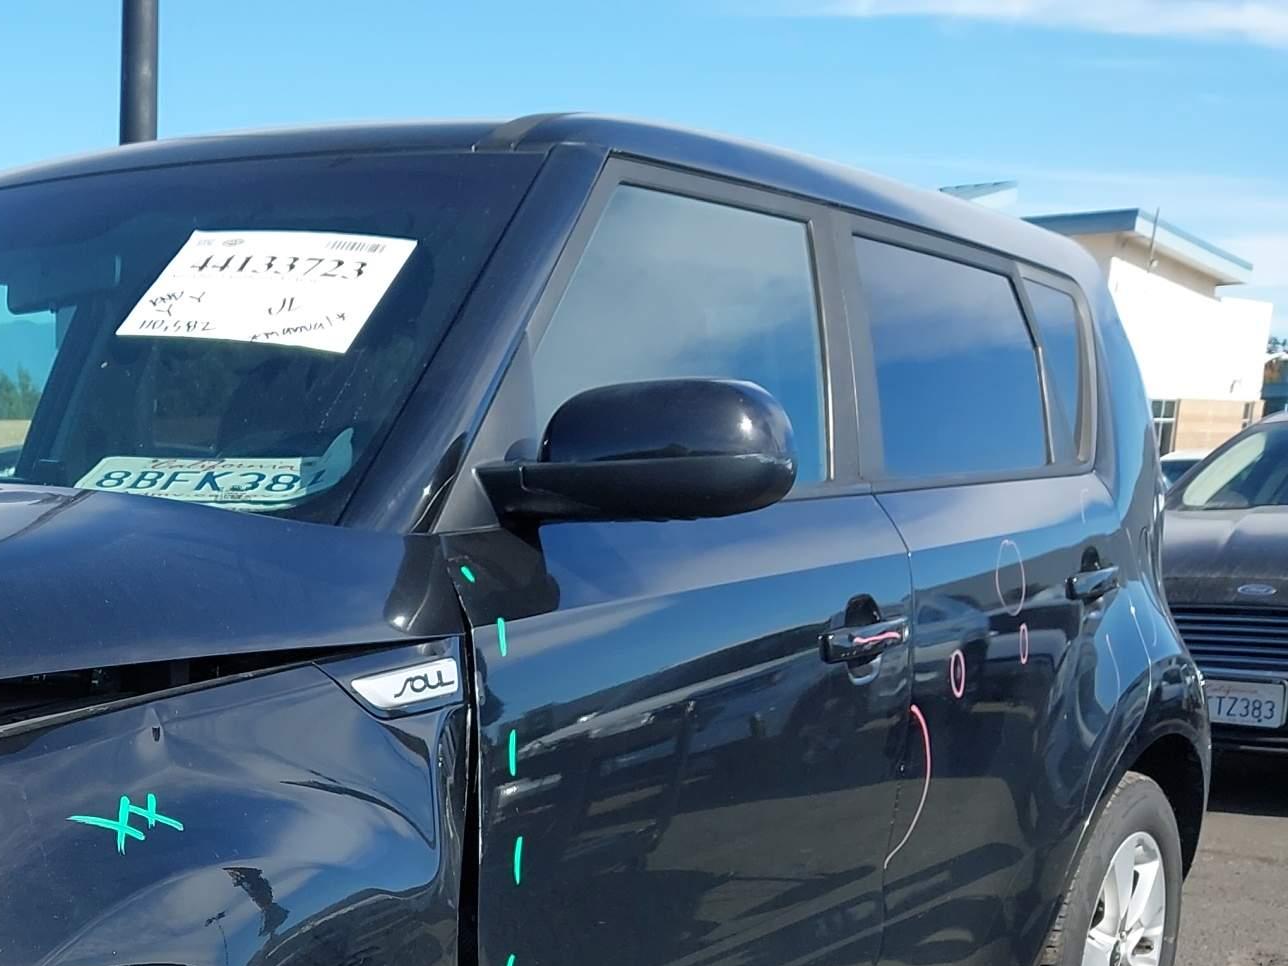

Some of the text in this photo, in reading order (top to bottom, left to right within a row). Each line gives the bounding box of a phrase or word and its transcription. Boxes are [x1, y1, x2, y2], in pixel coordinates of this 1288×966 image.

[190, 254, 368, 279] 44133723
[394, 670, 455, 699] SOUL
[1207, 695, 1276, 720] TZ383
